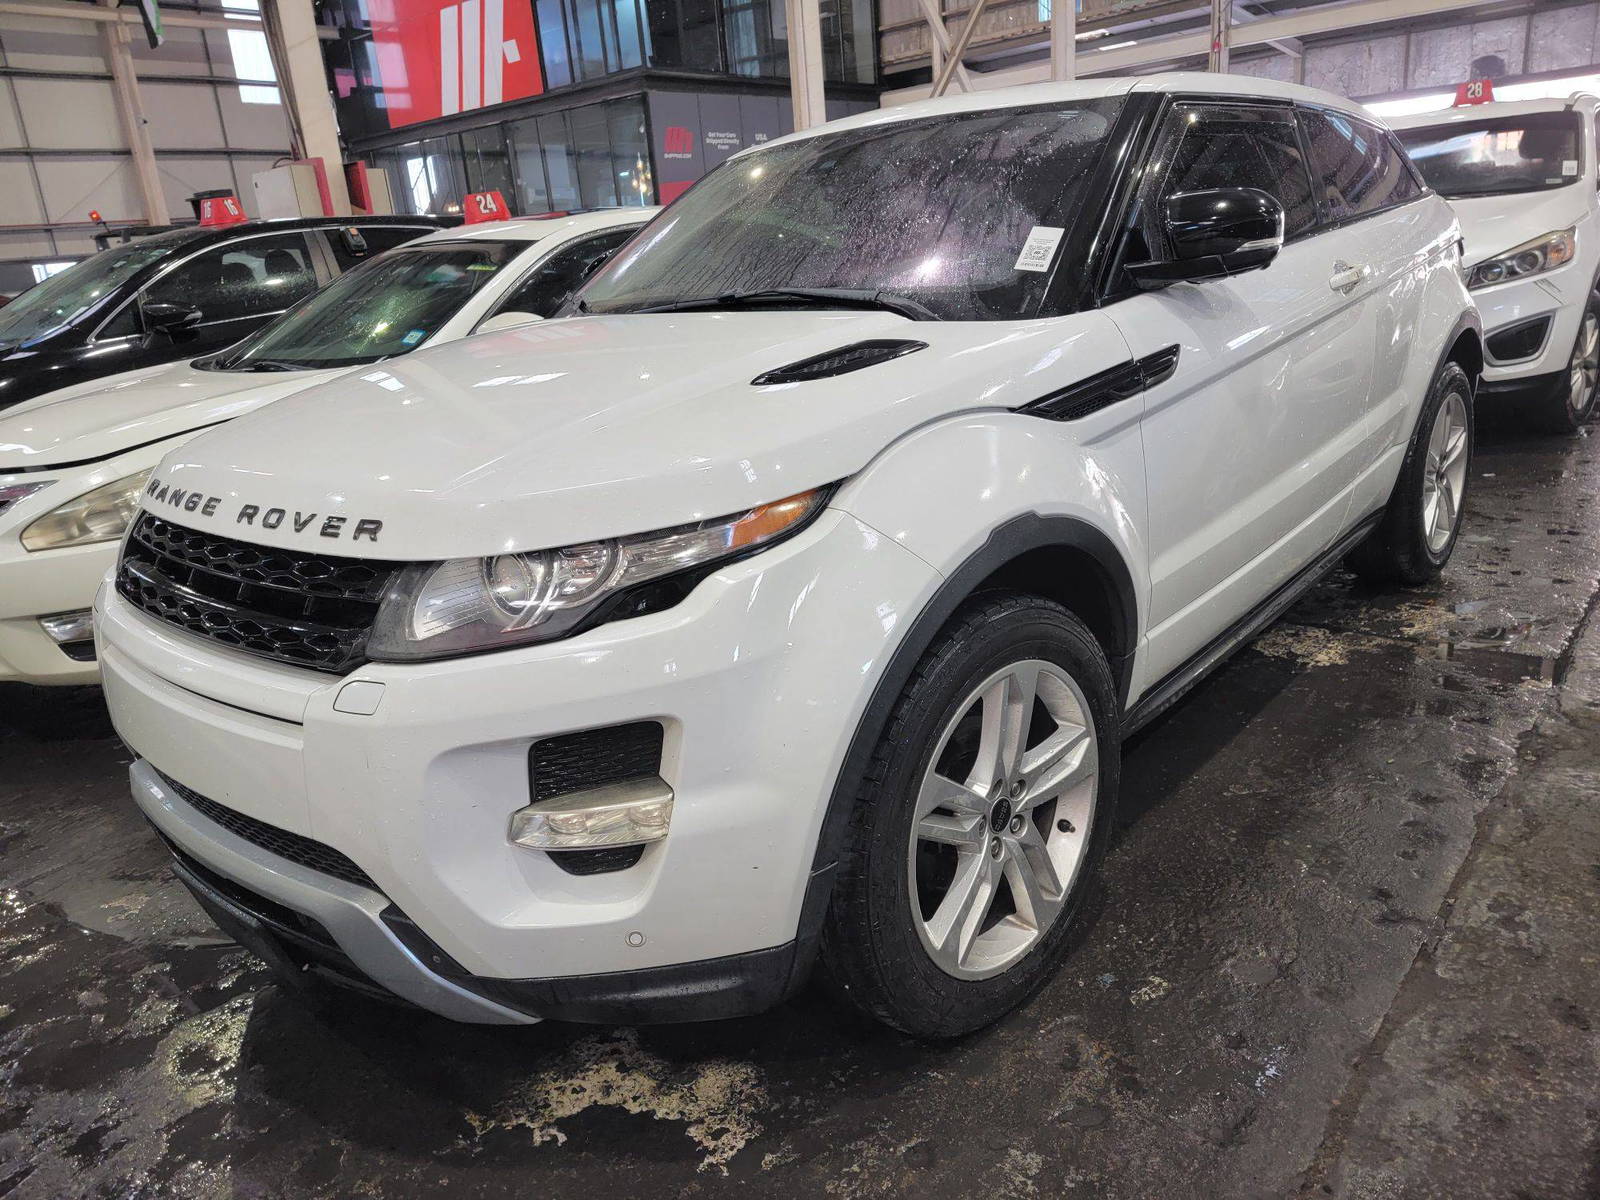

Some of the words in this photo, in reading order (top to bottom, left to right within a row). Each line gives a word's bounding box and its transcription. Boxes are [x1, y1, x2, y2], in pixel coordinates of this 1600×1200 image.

[1467, 82, 1483, 98] 28
[754, 133, 768, 141] USA
[223, 199, 239, 217] 16
[475, 194, 497, 214] 24
[146, 478, 222, 518] RANGE
[236, 504, 384, 542] ROVER
